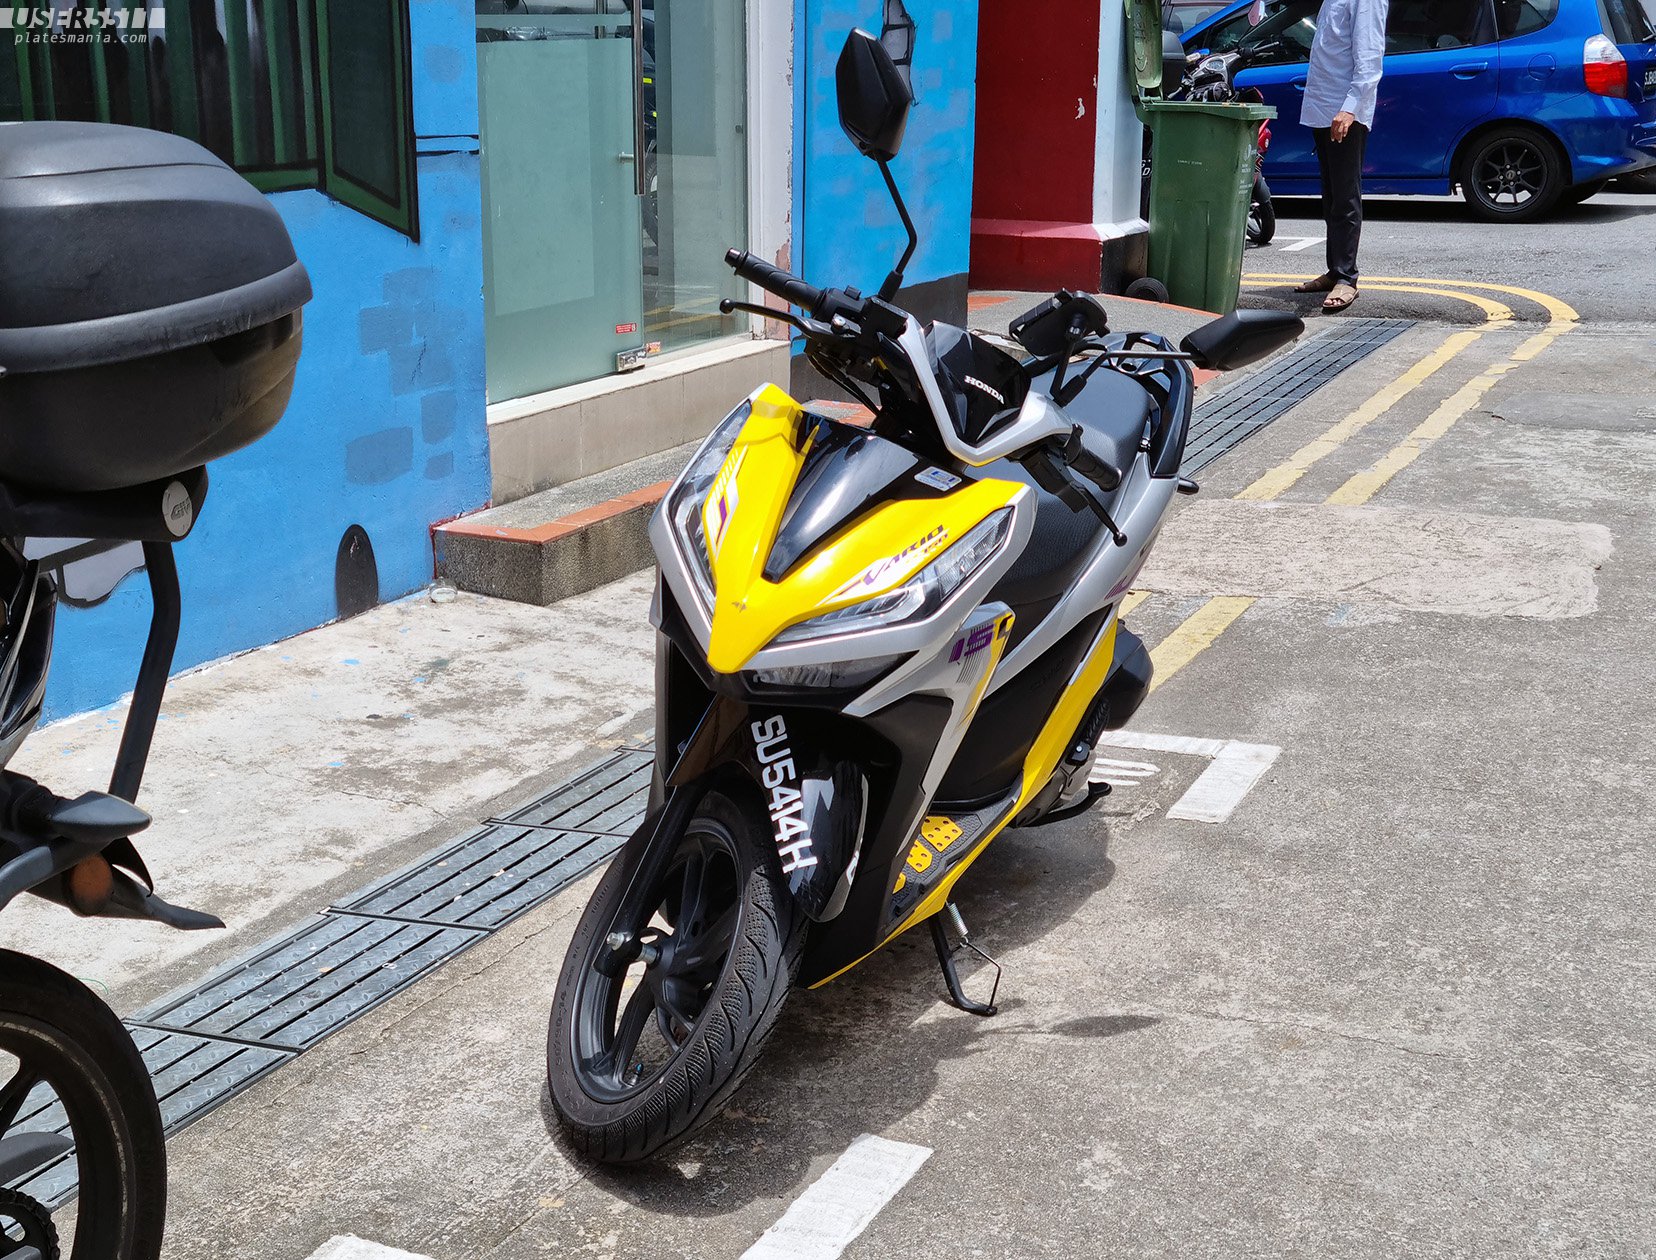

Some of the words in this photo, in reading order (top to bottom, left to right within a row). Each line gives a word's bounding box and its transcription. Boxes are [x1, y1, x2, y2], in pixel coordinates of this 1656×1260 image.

[964, 375, 1005, 405] HONDA
[863, 524, 944, 586] VARIO
[751, 714, 818, 874] SU5414H
